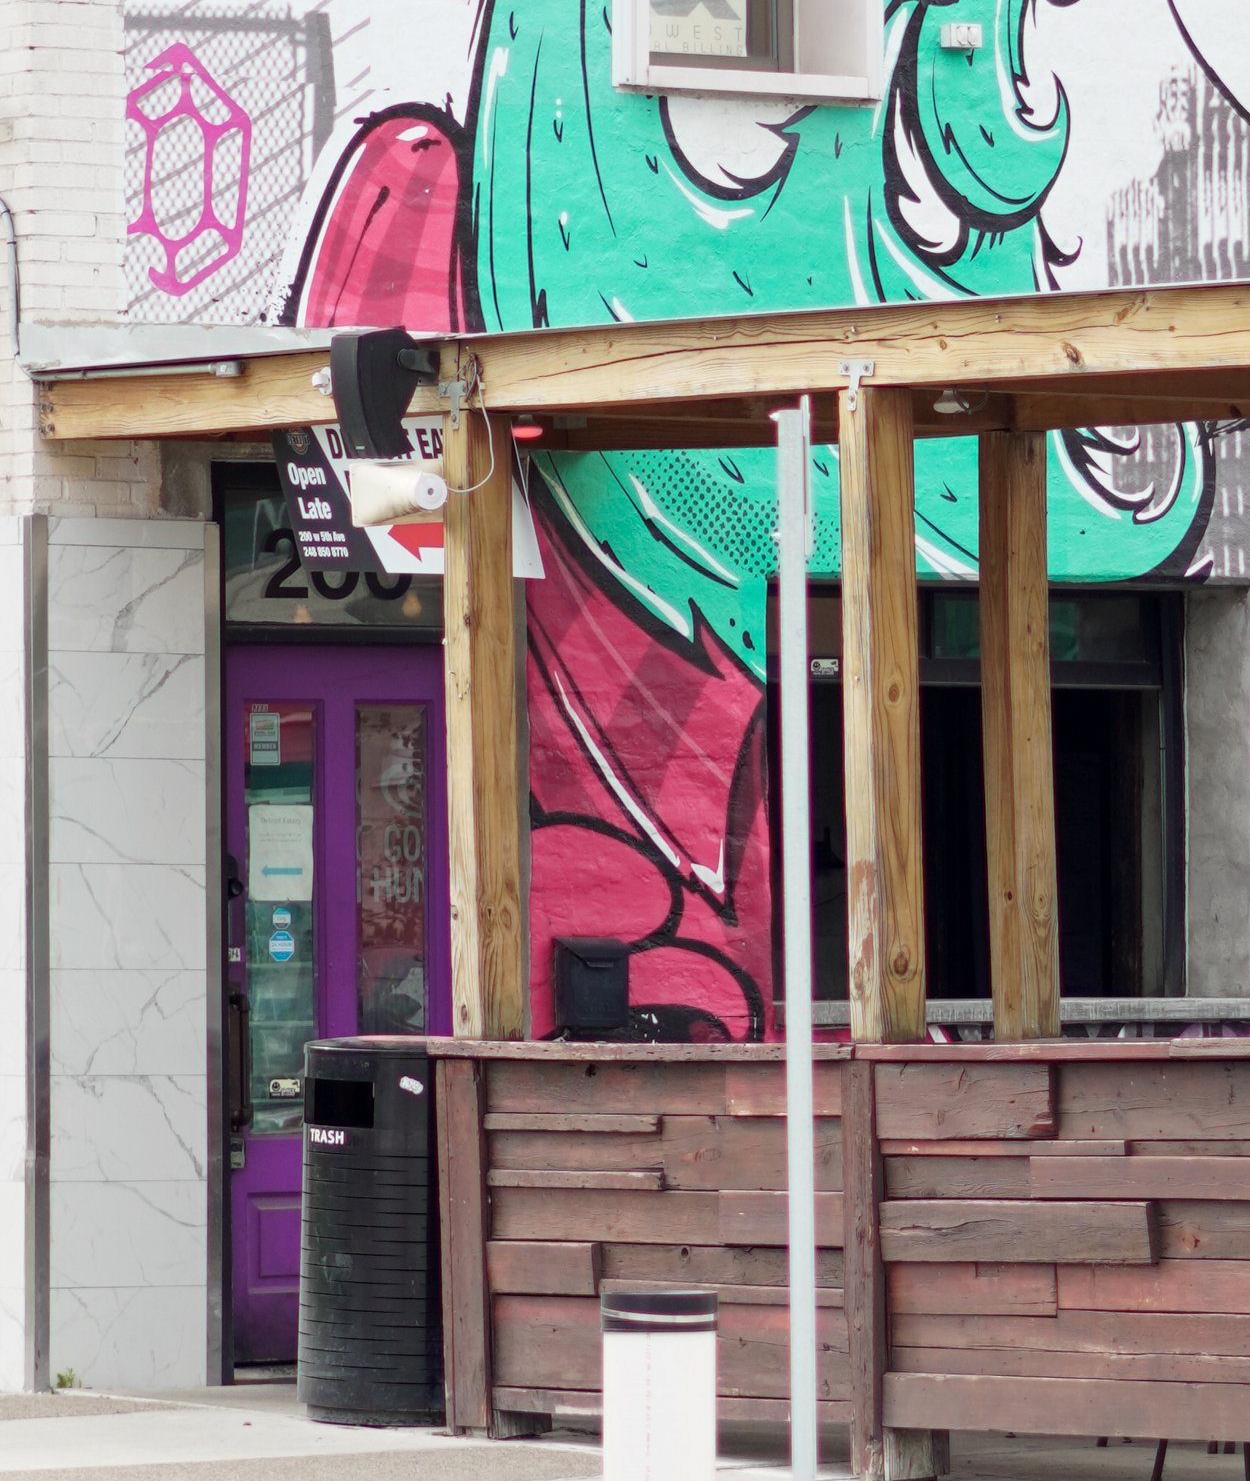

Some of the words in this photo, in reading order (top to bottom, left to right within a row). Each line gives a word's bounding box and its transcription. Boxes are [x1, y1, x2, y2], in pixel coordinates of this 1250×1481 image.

[649, 23, 743, 42] WEST
[287, 462, 327, 491] Open
[297, 496, 332, 520] Late
[310, 1127, 345, 1145] TRASH
